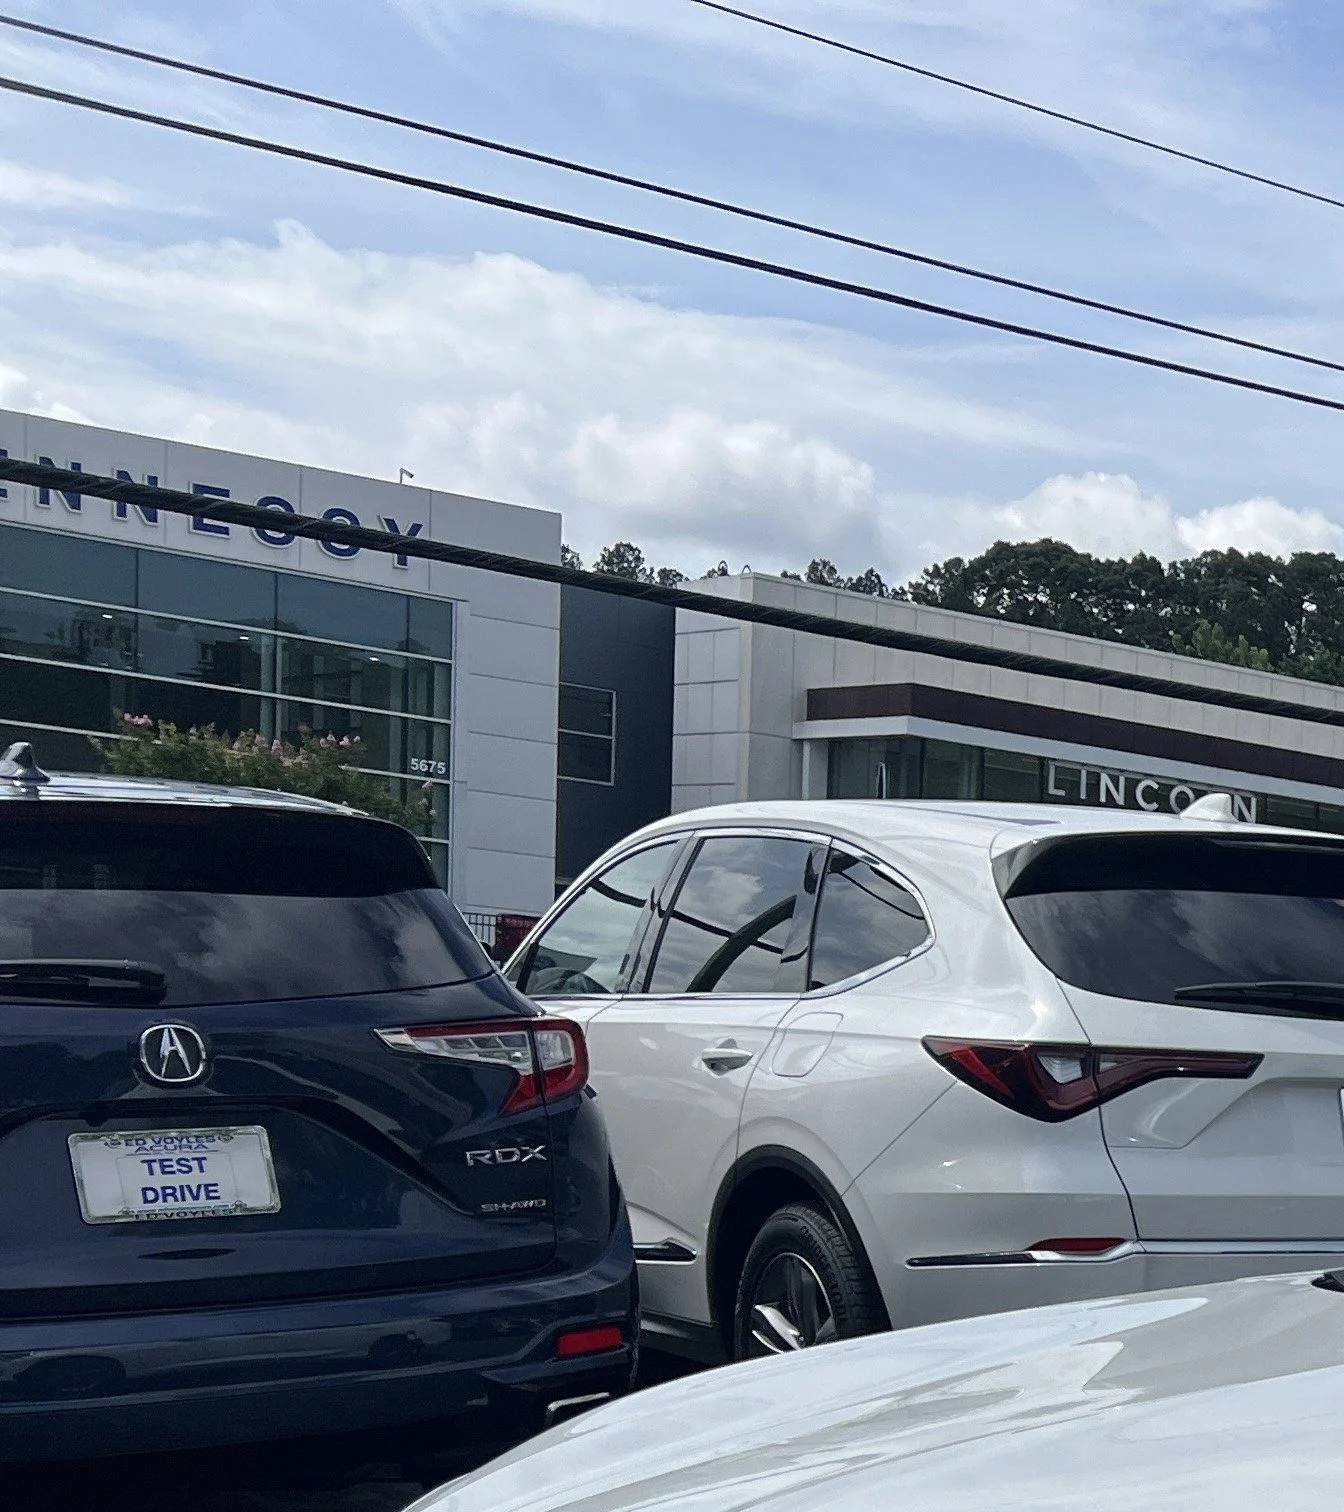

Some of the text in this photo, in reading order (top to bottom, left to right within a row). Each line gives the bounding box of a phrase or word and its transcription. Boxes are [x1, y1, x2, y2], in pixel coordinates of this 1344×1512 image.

[410, 759, 447, 775] 5675
[1048, 760, 1258, 824] LINCON
[125, 1135, 216, 1147] ED VOYLES
[135, 1144, 209, 1154] ACURA
[465, 1145, 547, 1167] RDX
[141, 1157, 207, 1176] TEST
[141, 1183, 221, 1204] DRIVE
